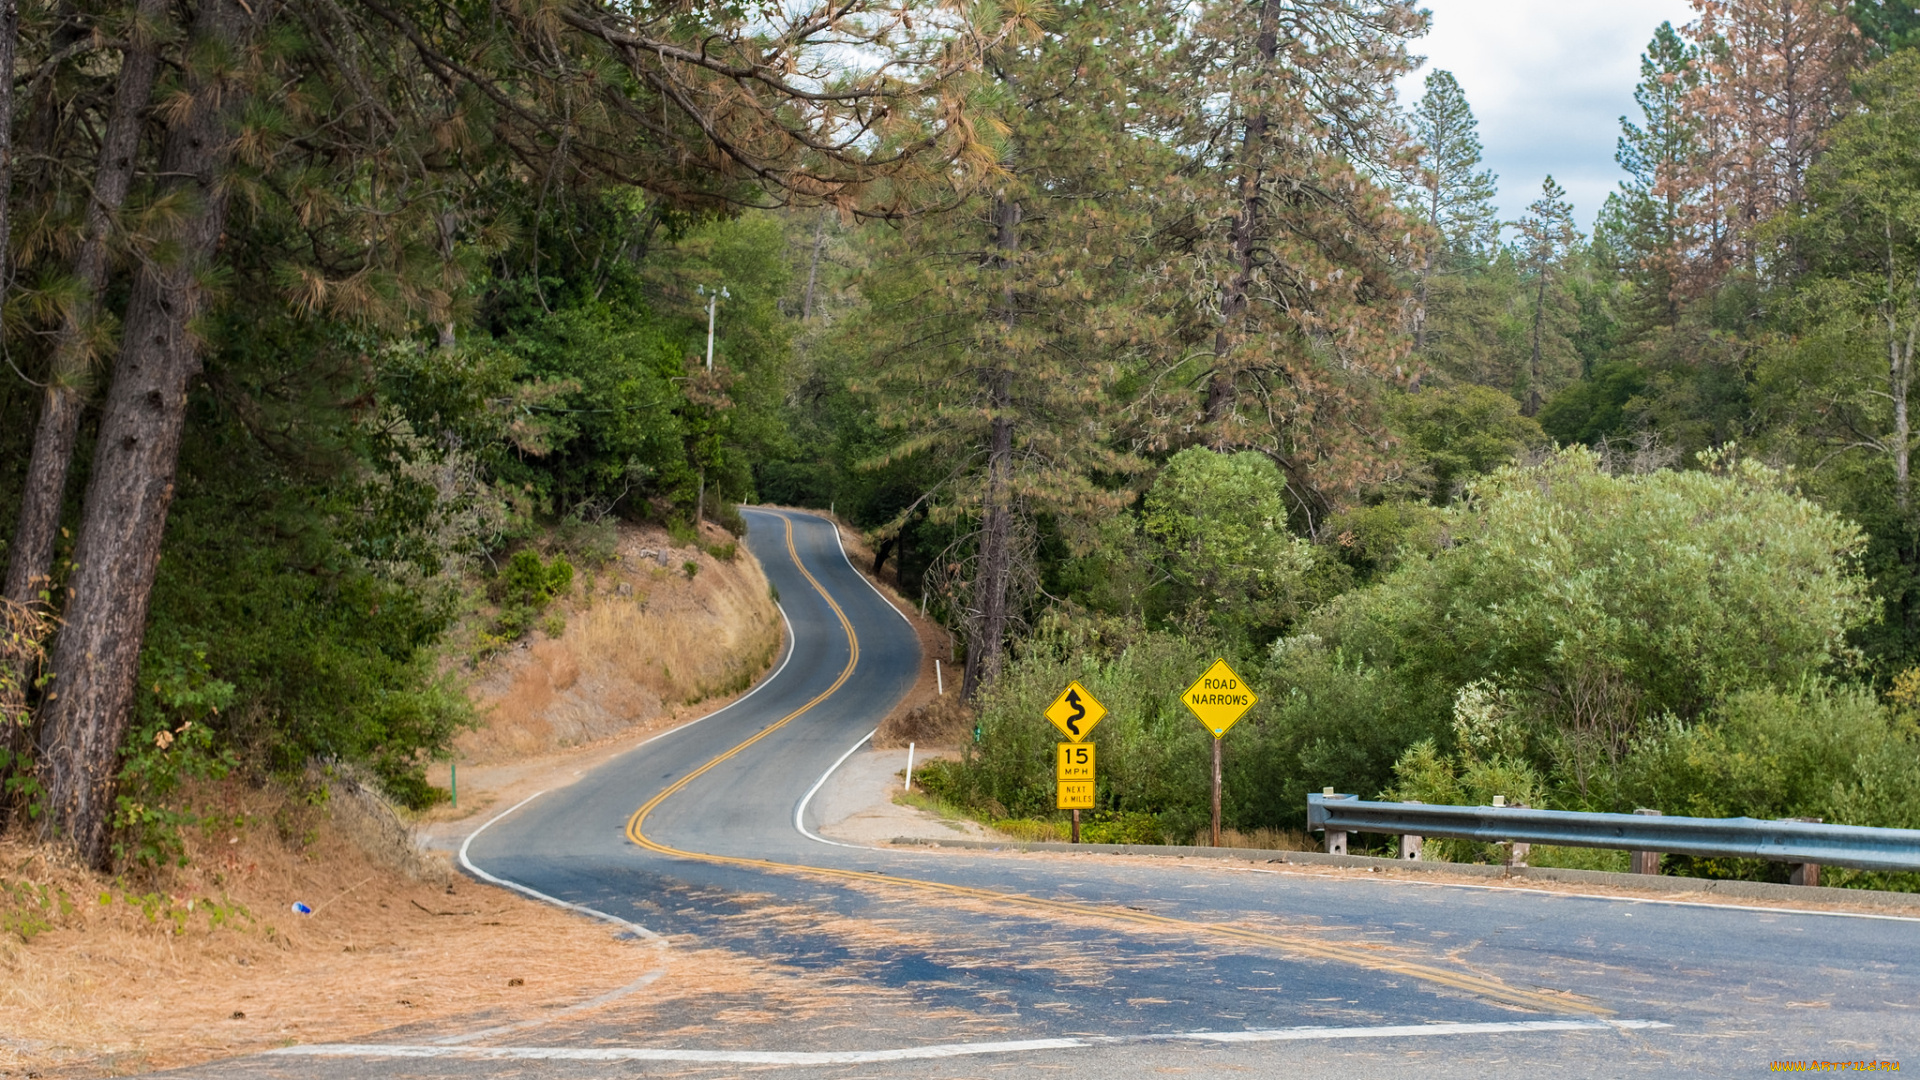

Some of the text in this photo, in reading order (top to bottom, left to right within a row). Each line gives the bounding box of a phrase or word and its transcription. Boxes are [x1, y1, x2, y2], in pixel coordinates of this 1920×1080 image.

[1204, 678, 1237, 690] ROAD
[1191, 693, 1248, 706] NARROWS
[1065, 748, 1088, 764] 15
[1070, 795, 1092, 803] MILES
